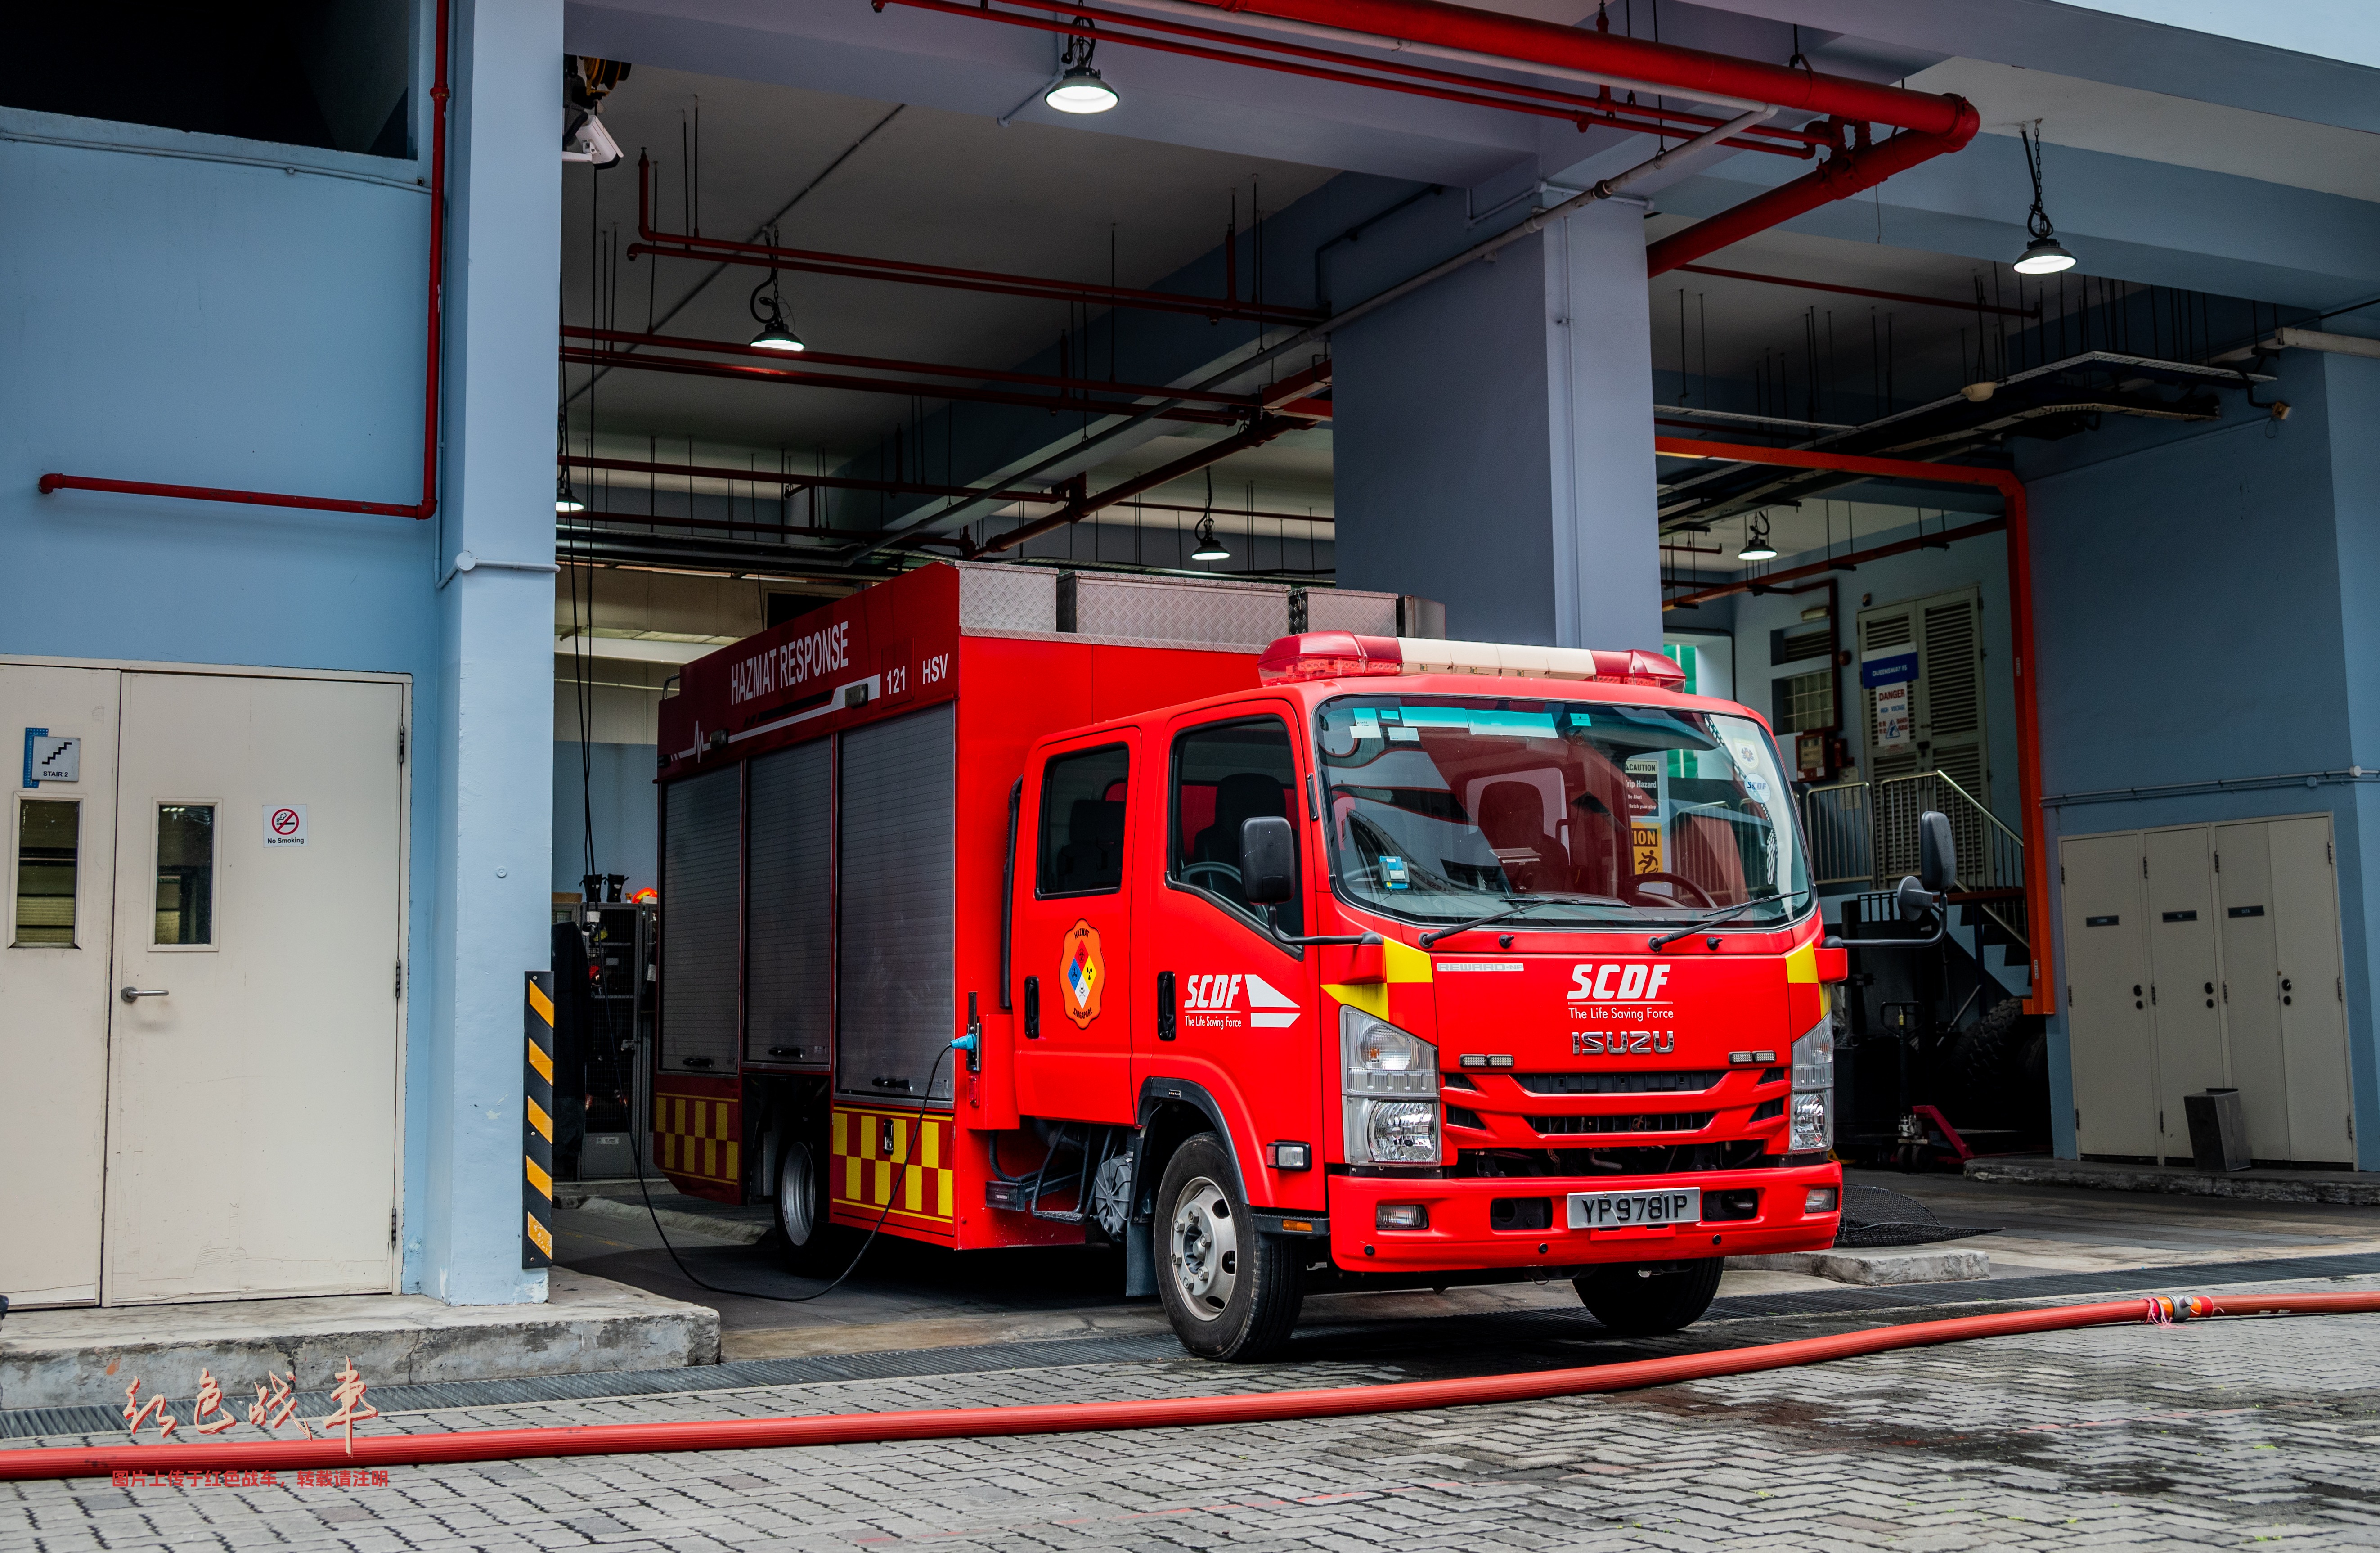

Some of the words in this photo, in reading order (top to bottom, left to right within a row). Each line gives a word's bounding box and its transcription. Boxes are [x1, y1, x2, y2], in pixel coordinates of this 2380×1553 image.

[732, 648, 777, 705] HAZMAT
[780, 621, 849, 689] RESPONSE
[923, 653, 948, 684] HSV
[1872, 666, 1901, 676] QUEENSWAY
[887, 666, 906, 695] 121
[1879, 689, 1905, 701] DANGER
[1629, 764, 1656, 772] CAUTION
[1626, 780, 1635, 789] rip
[1636, 780, 1657, 788] Hazard
[1747, 781, 1766, 790] SCDF
[1632, 830, 1656, 845] ION
[1074, 928, 1090, 940] HAZMAT
[1566, 964, 1671, 999] SCDF
[1184, 974, 1242, 1008] SCDF
[1073, 1007, 1093, 1019] SINGAPORE
[1568, 1007, 1587, 1019] The
[1590, 1007, 1608, 1019] Life
[1611, 1007, 1644, 1022] Saving
[1647, 1007, 1674, 1018] Force
[1185, 1015, 1194, 1026] The
[1196, 1015, 1205, 1026] Life
[1206, 1016, 1224, 1030] Saving
[1226, 1016, 1241, 1027] Force
[1572, 1031, 1674, 1054] ISUZU
[1581, 1194, 1687, 1223] YP9781P
